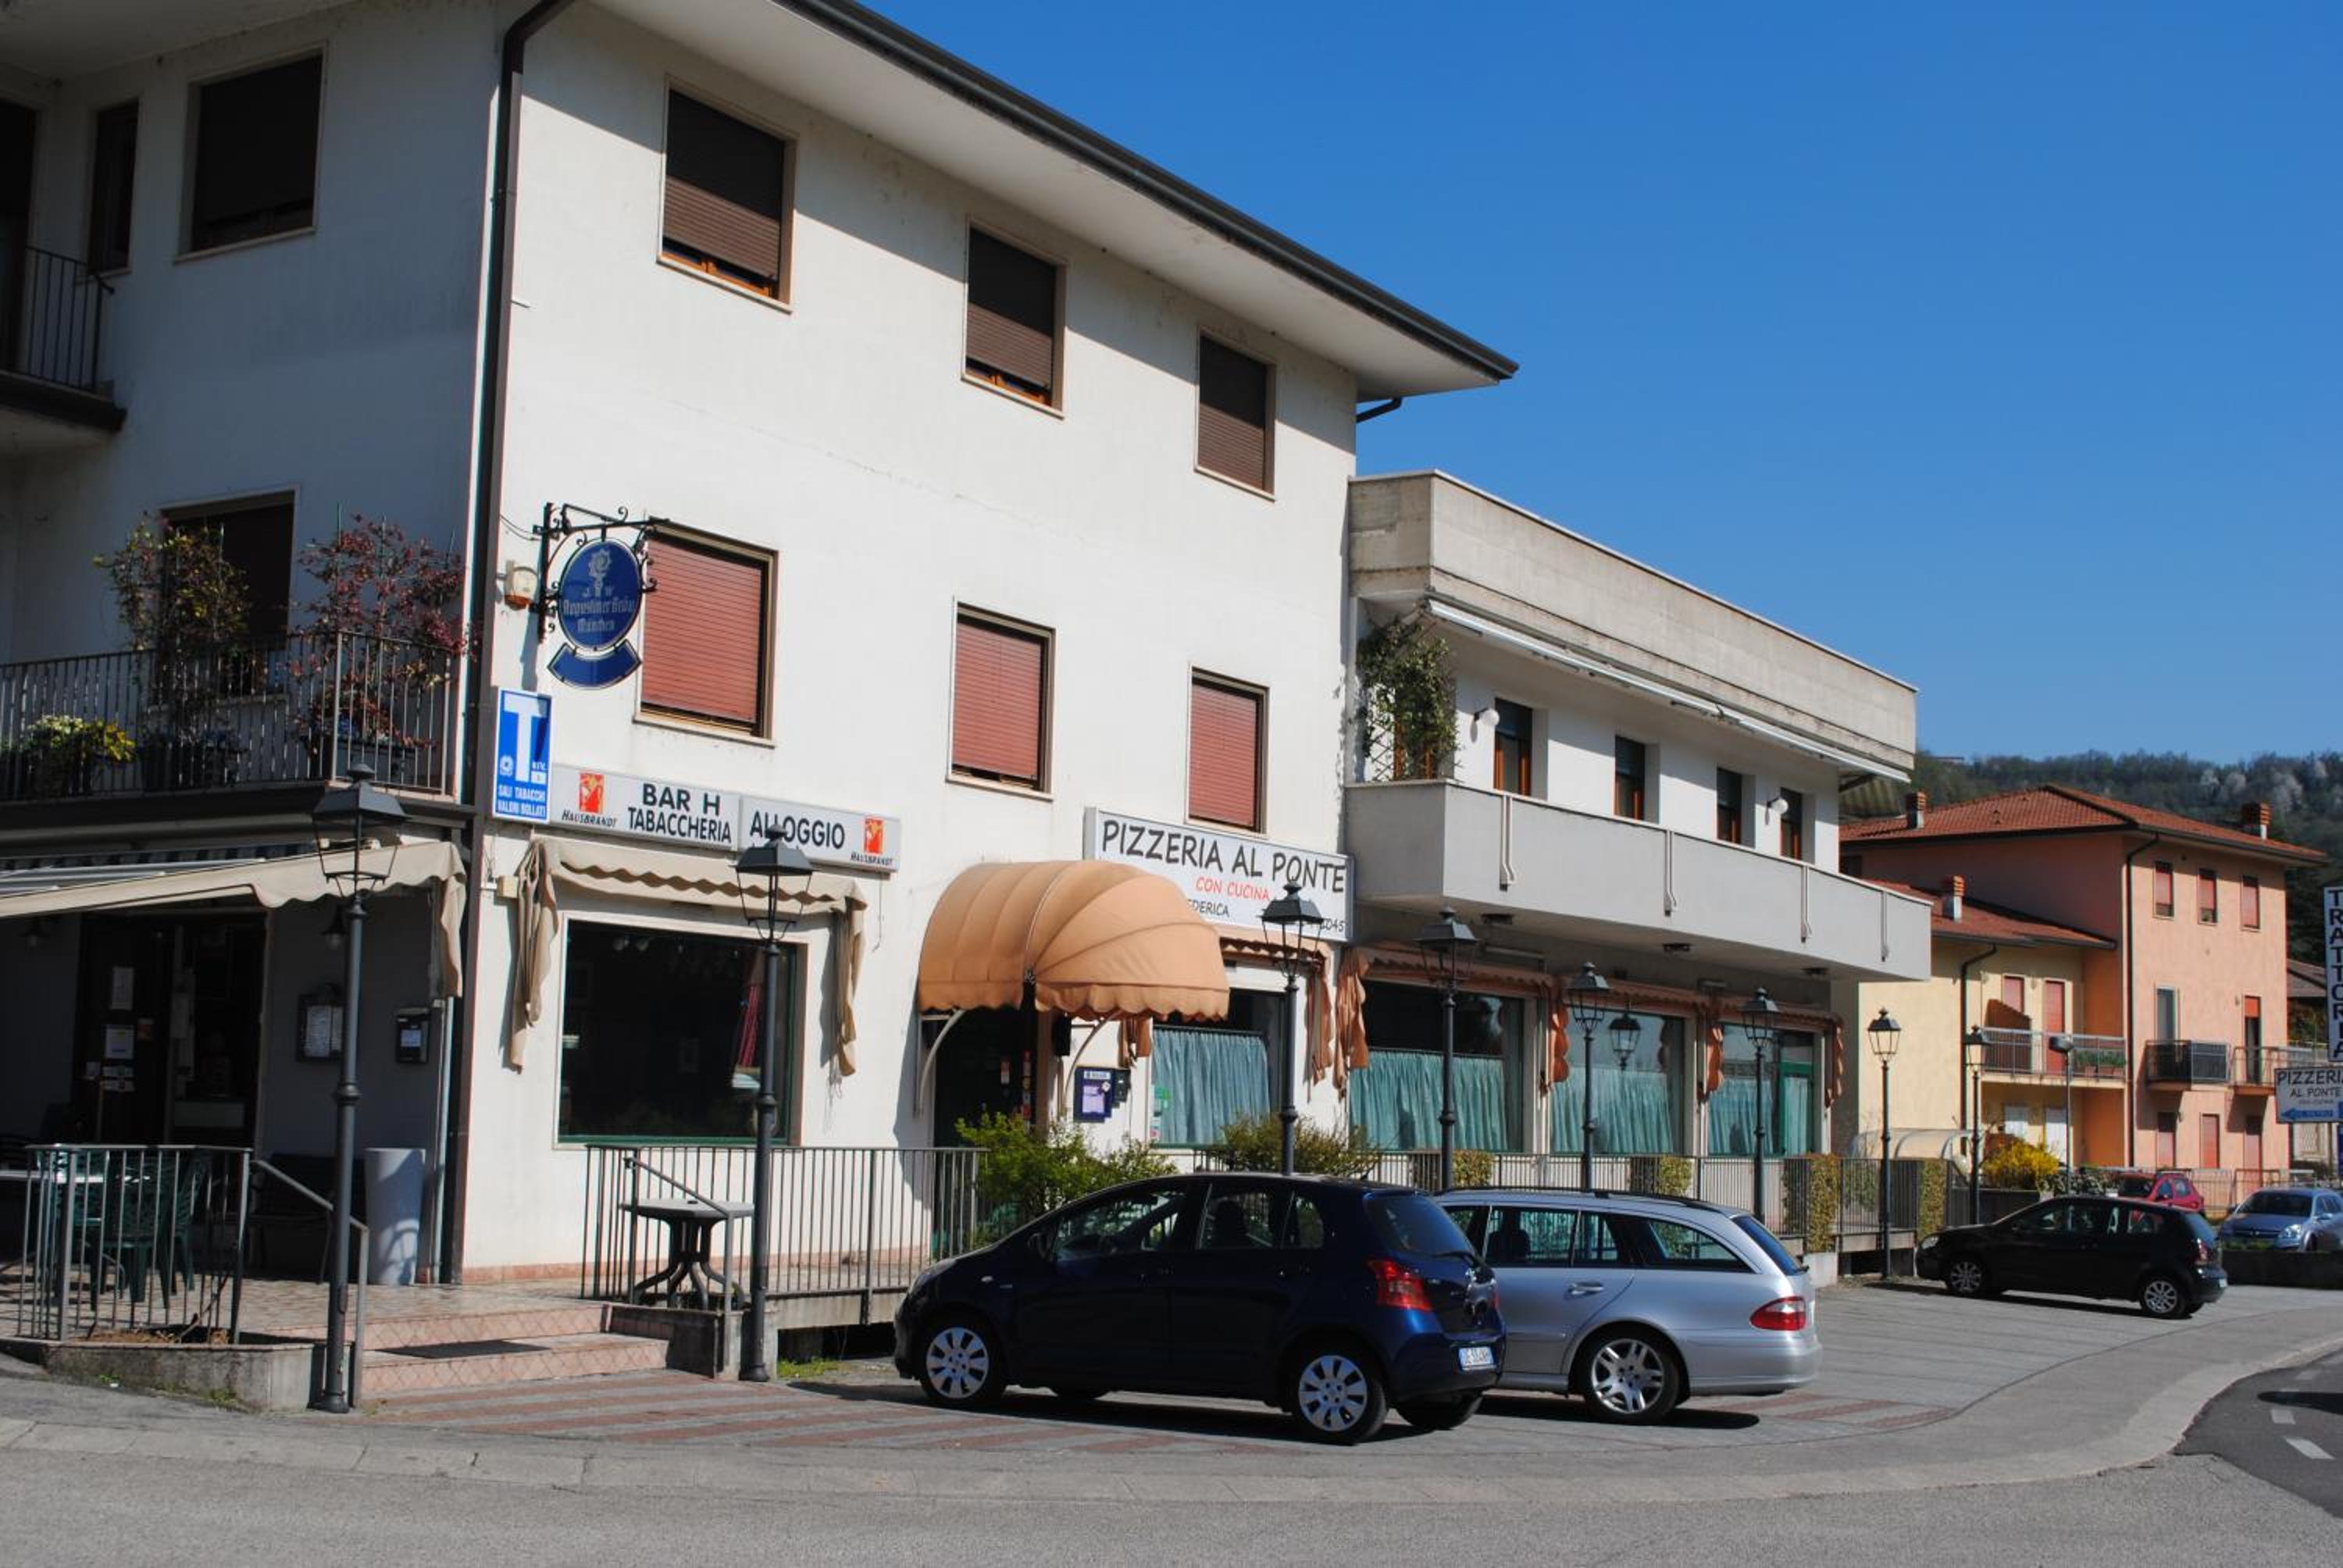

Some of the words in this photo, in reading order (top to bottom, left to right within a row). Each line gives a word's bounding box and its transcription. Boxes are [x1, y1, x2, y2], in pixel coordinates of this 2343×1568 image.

[504, 692, 548, 783] T
[642, 782, 691, 812] BAR
[703, 792, 721, 817] H
[628, 807, 732, 844] TABACCHERIA
[1102, 819, 1224, 872] PIZZERIA
[1232, 845, 1263, 878] AL
[1271, 851, 1346, 893] PONTE
[1195, 877, 1223, 895] CON
[1227, 881, 1270, 901] CUCINA
[2277, 1069, 2343, 1085] PIZZERI
